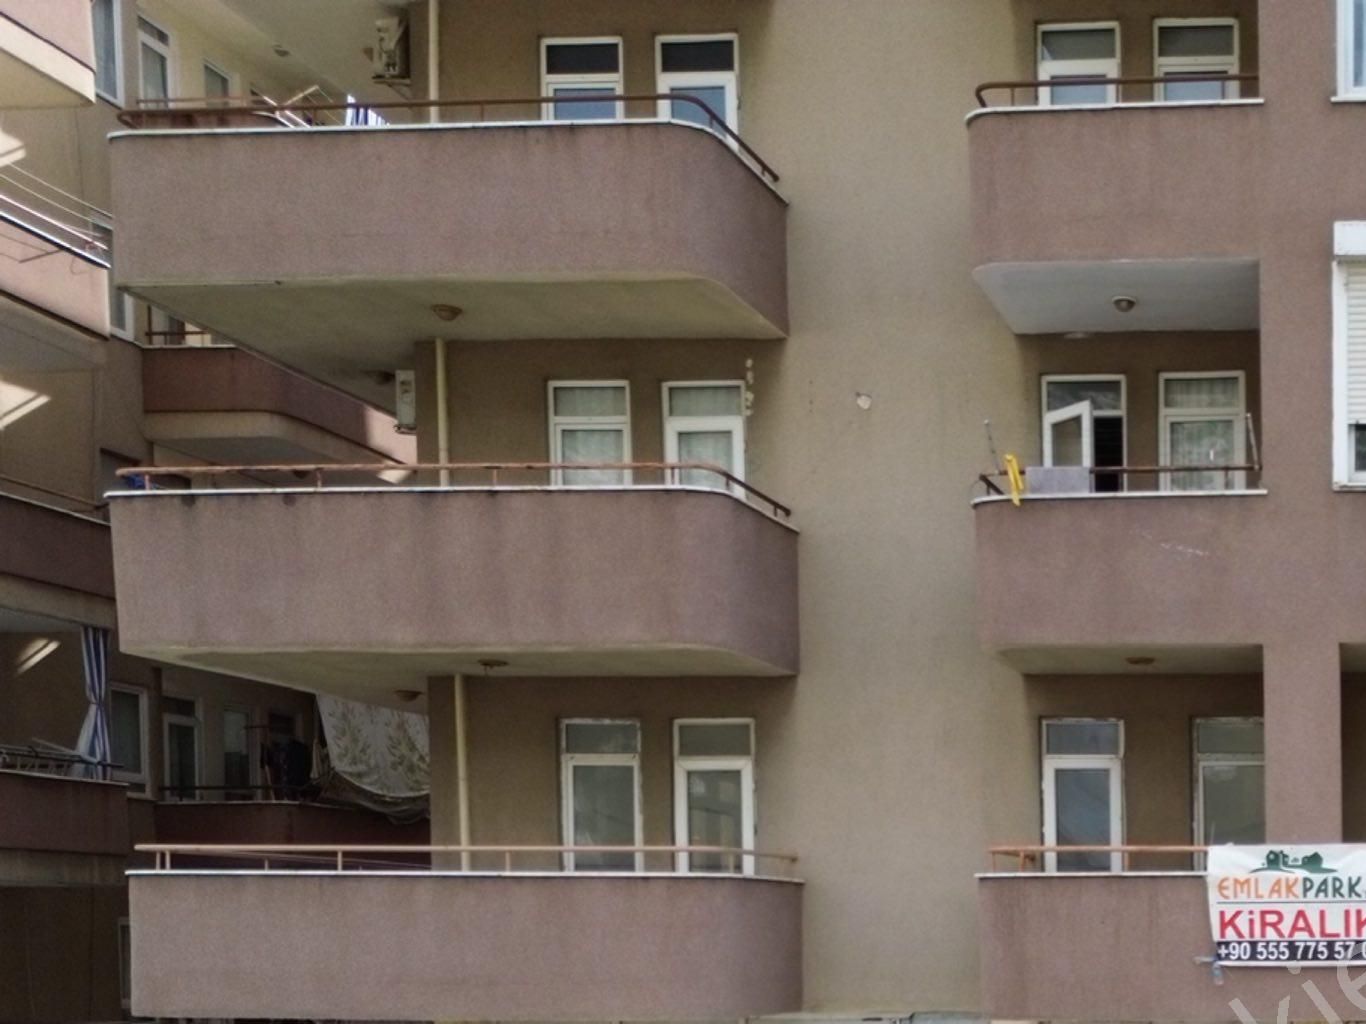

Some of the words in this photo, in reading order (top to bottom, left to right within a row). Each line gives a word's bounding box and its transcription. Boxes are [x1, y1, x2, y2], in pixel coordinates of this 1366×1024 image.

[1218, 942, 1251, 960] +90
[1256, 942, 1290, 960] 555
[1294, 941, 1329, 960] 775
[1334, 941, 1356, 959] 57
